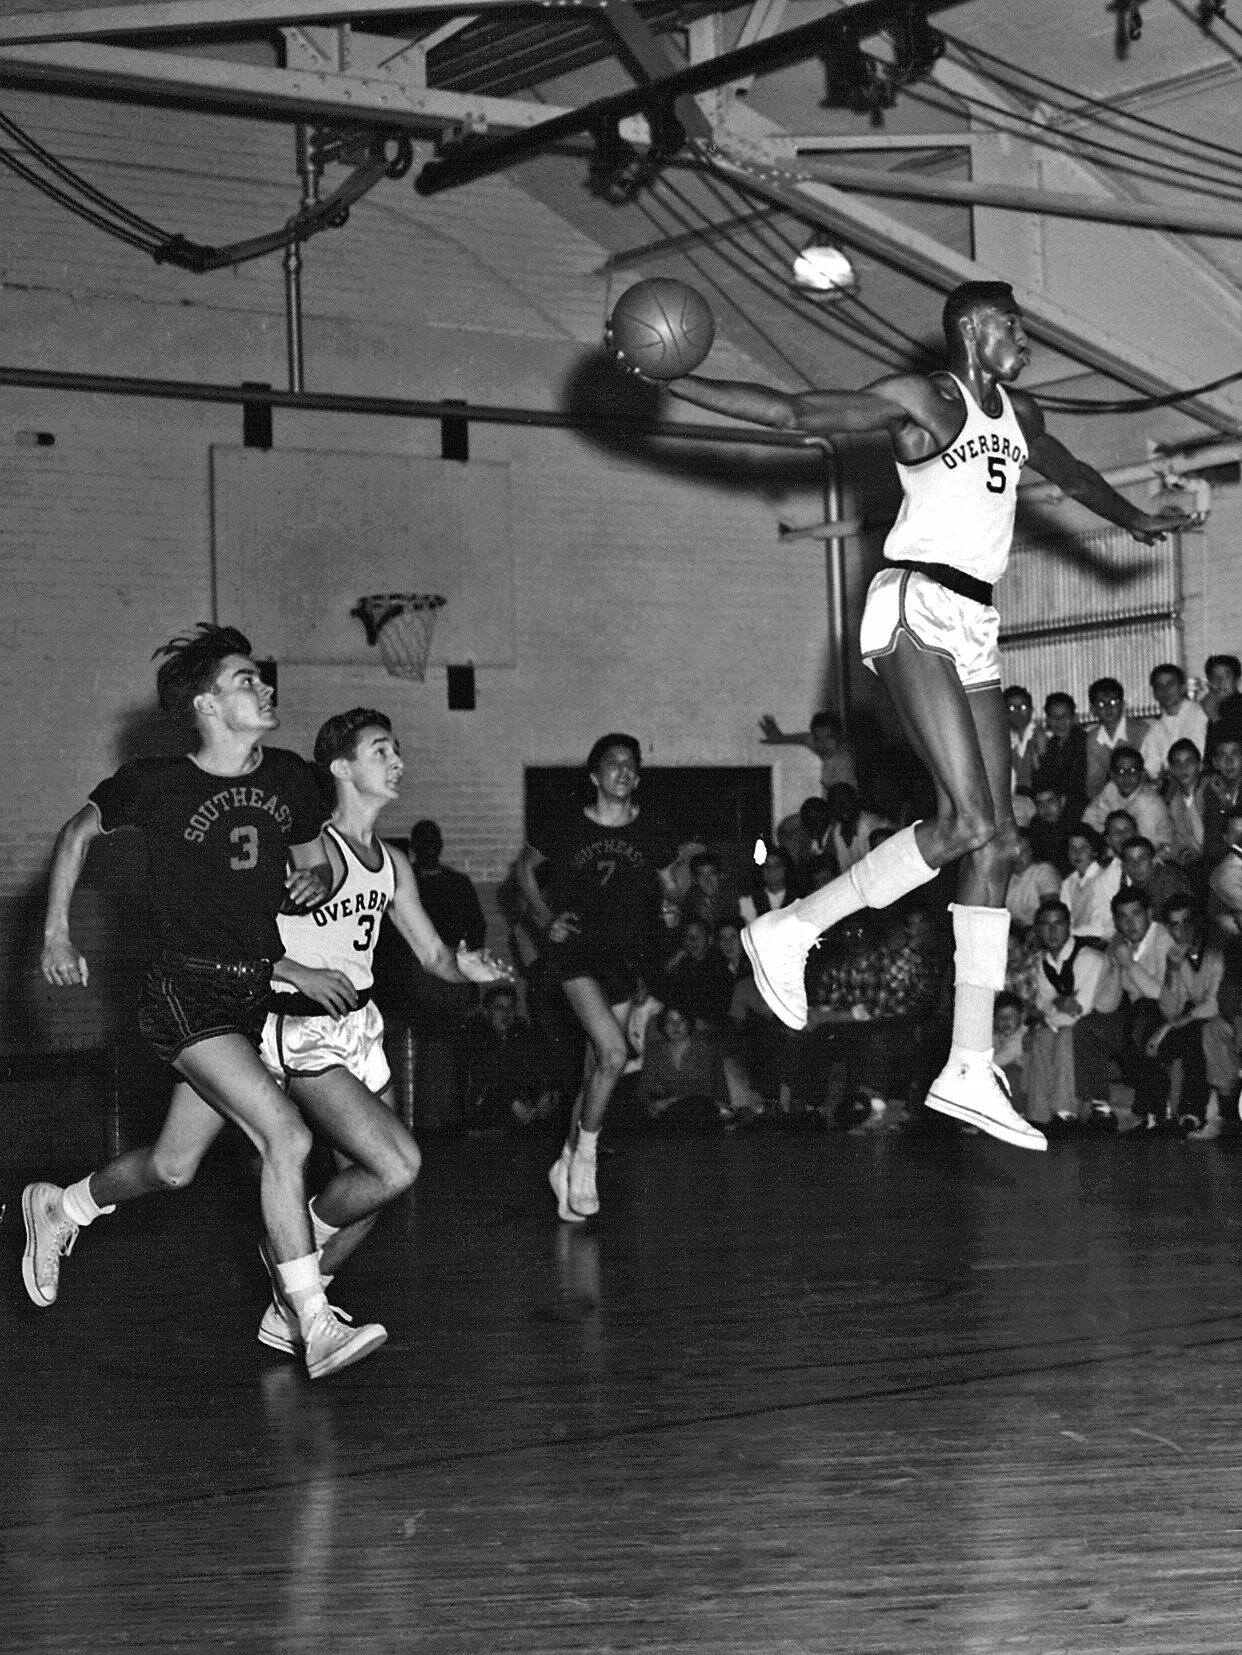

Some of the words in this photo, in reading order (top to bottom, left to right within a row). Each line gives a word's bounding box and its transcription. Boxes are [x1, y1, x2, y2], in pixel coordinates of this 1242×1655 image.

[986, 456, 1007, 494] 5
[230, 825, 259, 871] 3
[597, 860, 615, 886] 7
[353, 915, 375, 951] 3
